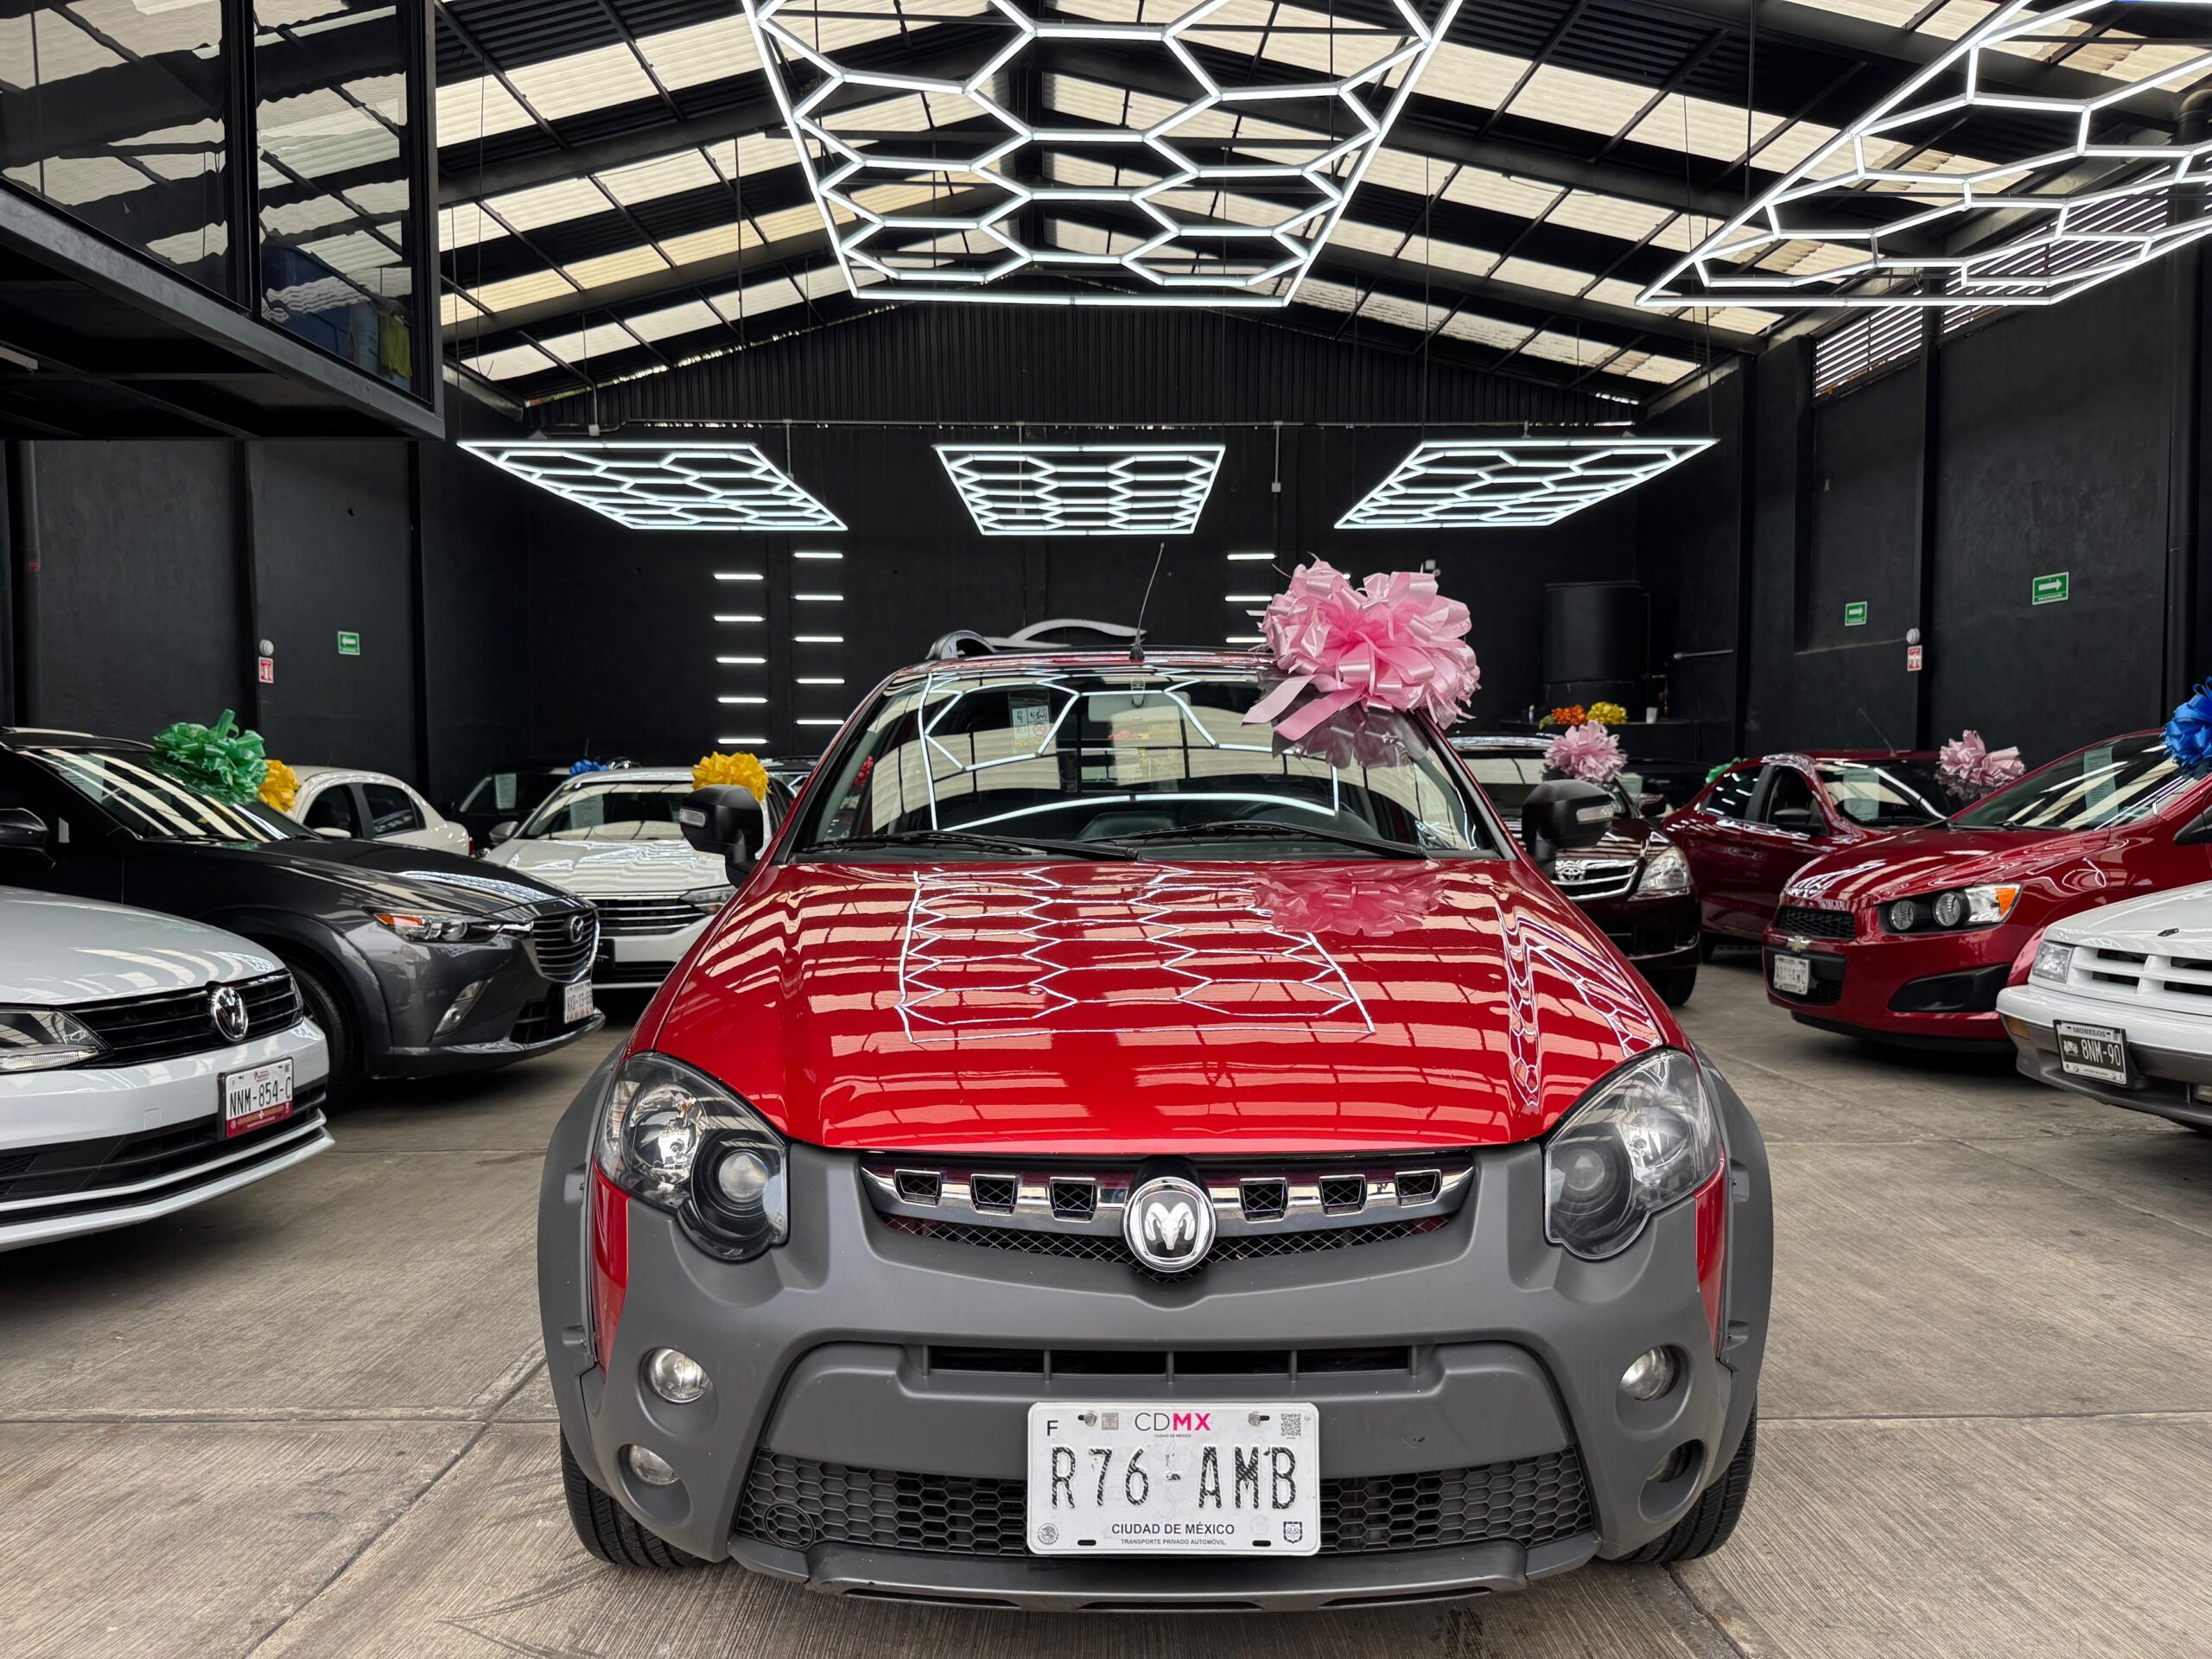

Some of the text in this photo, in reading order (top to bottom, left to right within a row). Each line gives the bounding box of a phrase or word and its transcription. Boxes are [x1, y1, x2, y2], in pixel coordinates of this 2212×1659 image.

[2072, 1027, 2106, 1038] MORELOS
[2081, 1039, 2121, 1066] 8NM-90
[230, 1076, 291, 1118] NNM-854-C
[1046, 1420, 1058, 1436] F
[1135, 1412, 1211, 1432] CDMX
[1051, 1446, 1297, 1510] R76-AMB
[1111, 1522, 1235, 1535] CIUDAD DE MÉXICO
